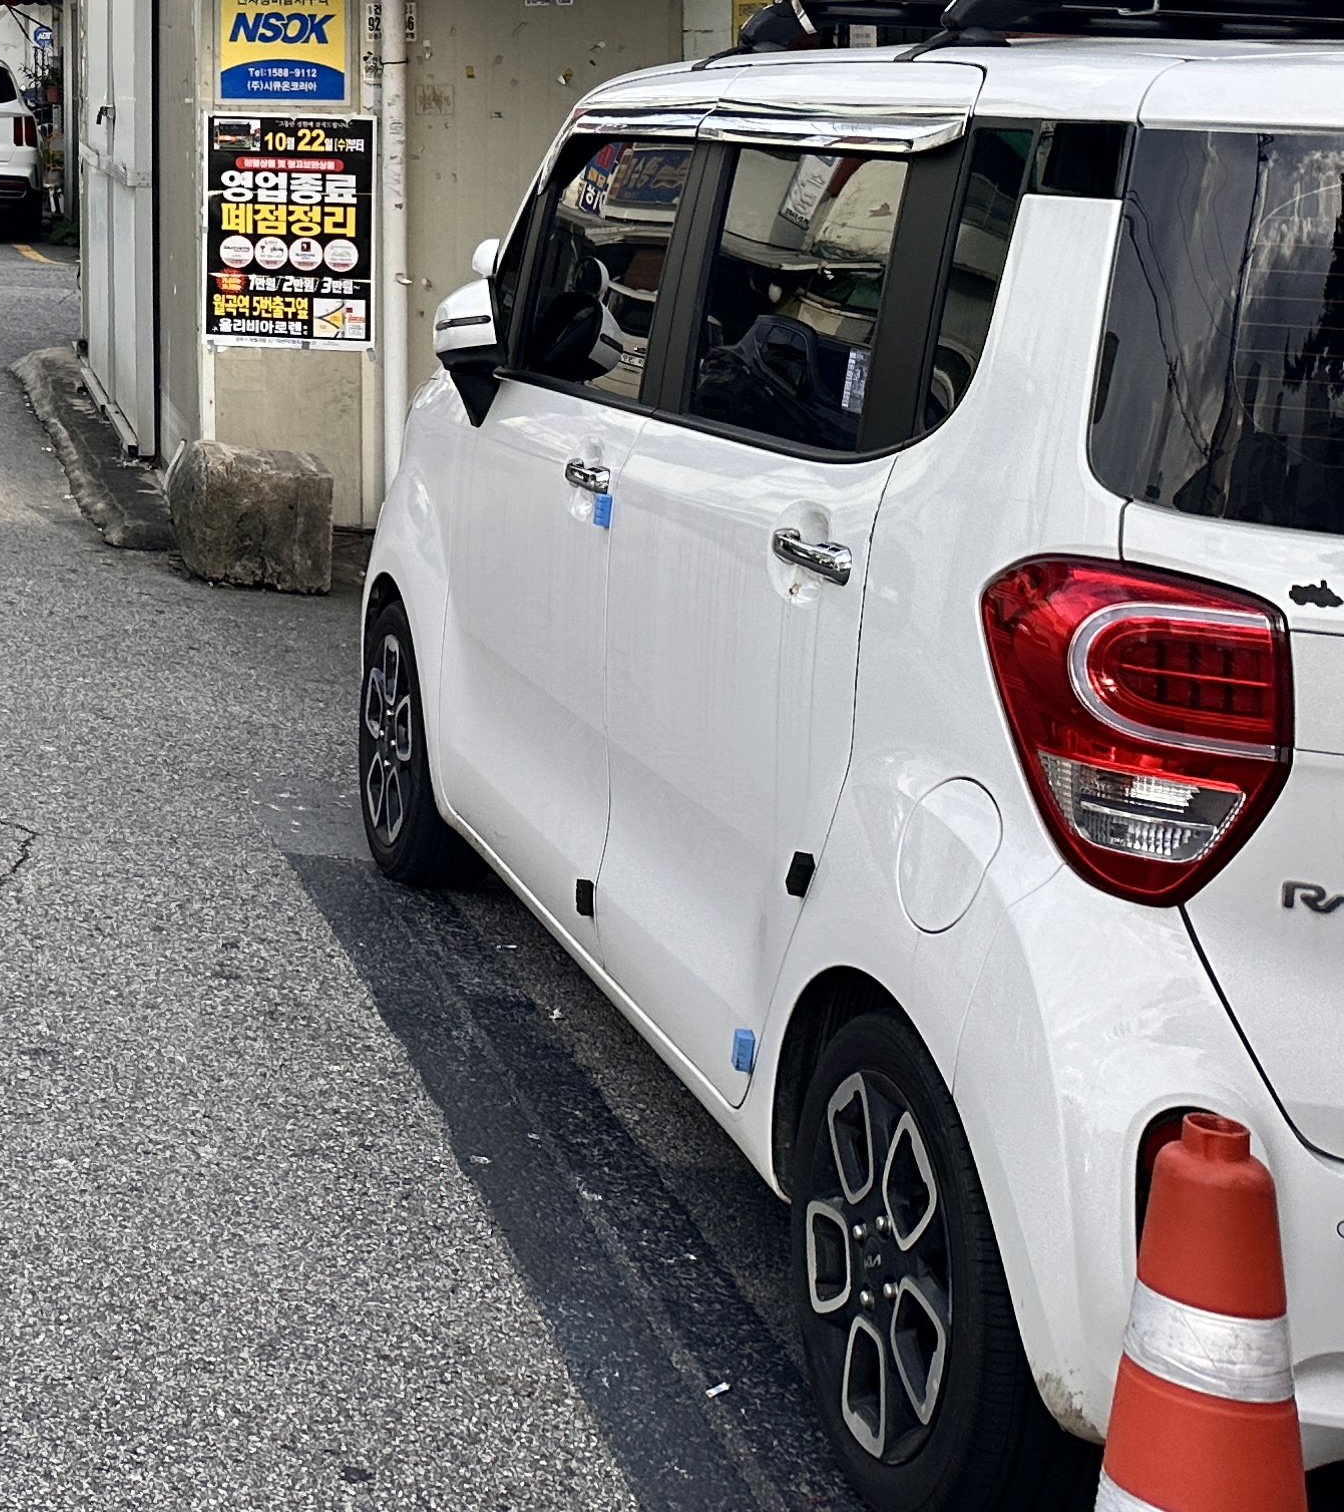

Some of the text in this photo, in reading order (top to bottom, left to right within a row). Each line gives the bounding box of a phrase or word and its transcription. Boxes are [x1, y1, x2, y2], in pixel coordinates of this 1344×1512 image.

[229, 12, 336, 44] NSOK
[264, 132, 295, 151] 10월
[220, 170, 358, 205] 영업종료
[221, 203, 357, 237] 폐점정리
[212, 293, 309, 320] 월곡역 5번출구옆
